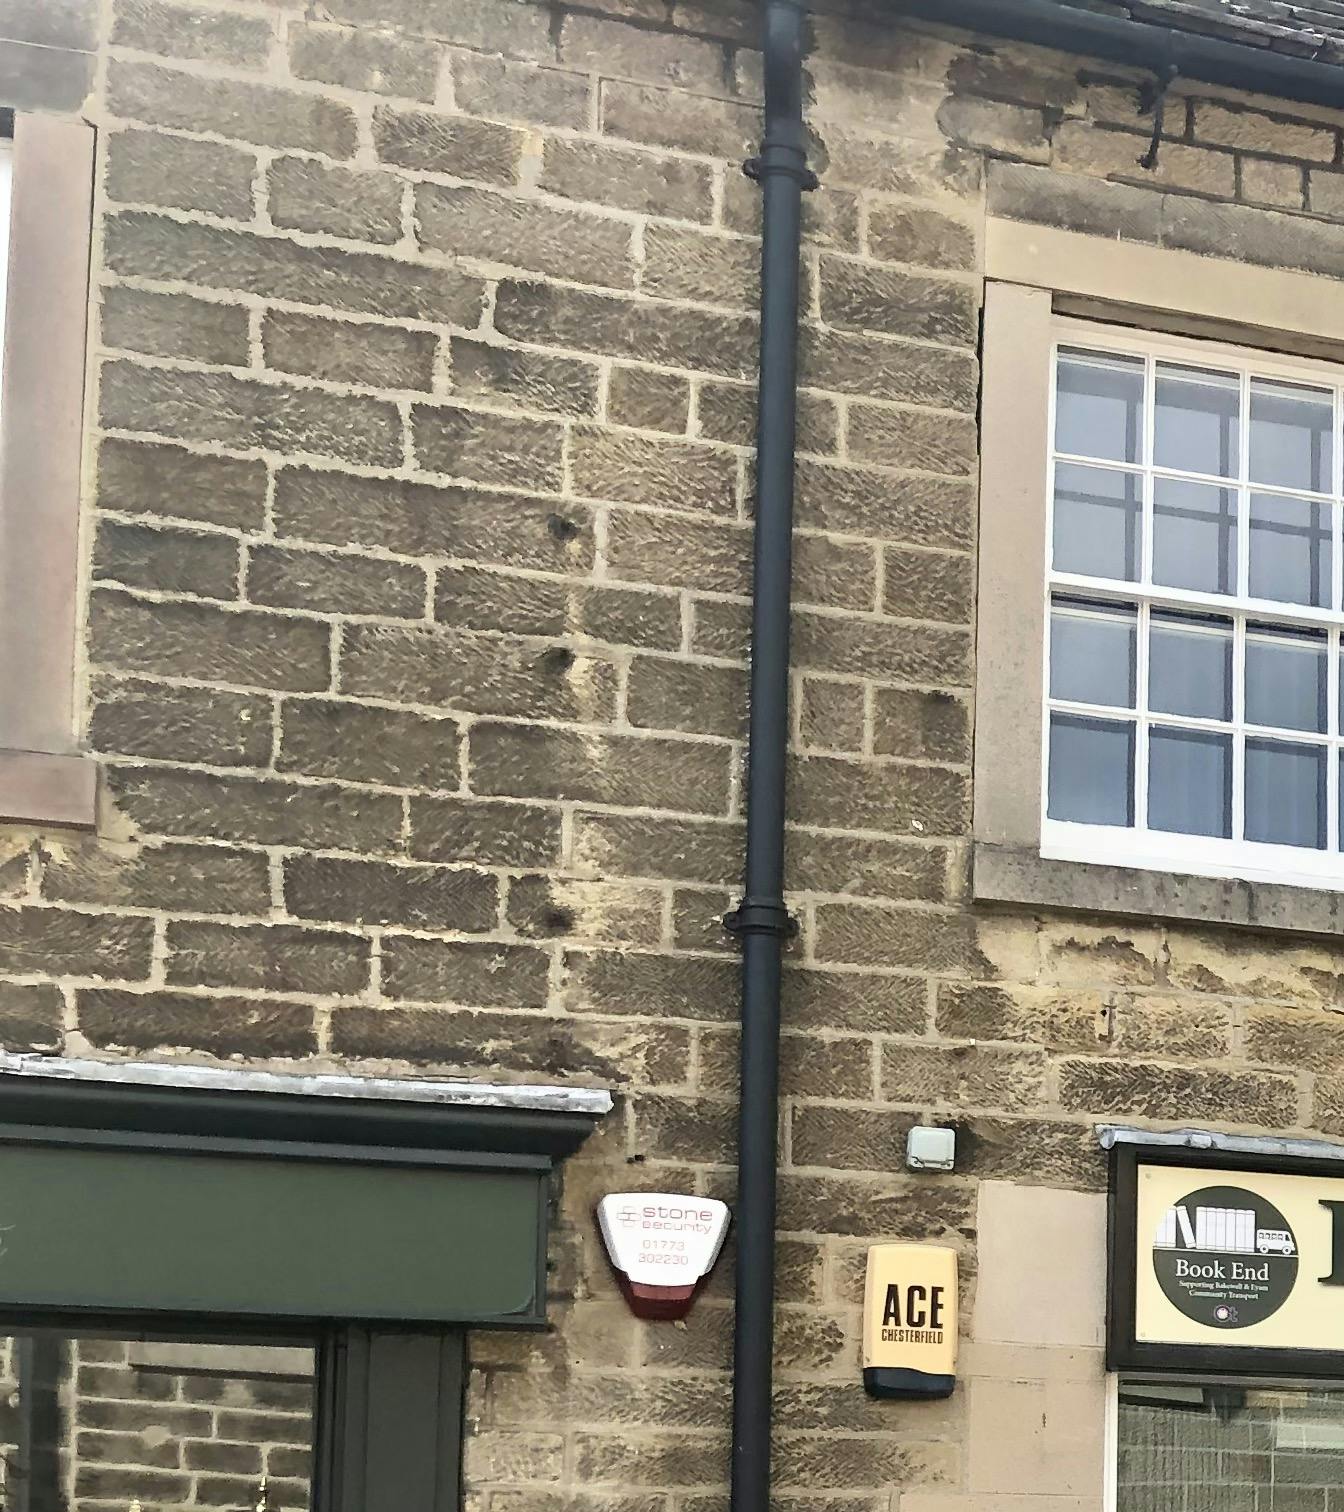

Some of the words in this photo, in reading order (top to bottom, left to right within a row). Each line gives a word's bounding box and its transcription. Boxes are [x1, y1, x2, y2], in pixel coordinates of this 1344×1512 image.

[643, 1206, 713, 1221] stone
[642, 1221, 712, 1235] security
[642, 1239, 685, 1252] 01773
[1175, 1258, 1226, 1279] Book
[1231, 1262, 1270, 1281] End
[1178, 1280, 1215, 1291] Supporting
[881, 1283, 945, 1330] ACE
[881, 1328, 944, 1345] CHESTERFIELD
